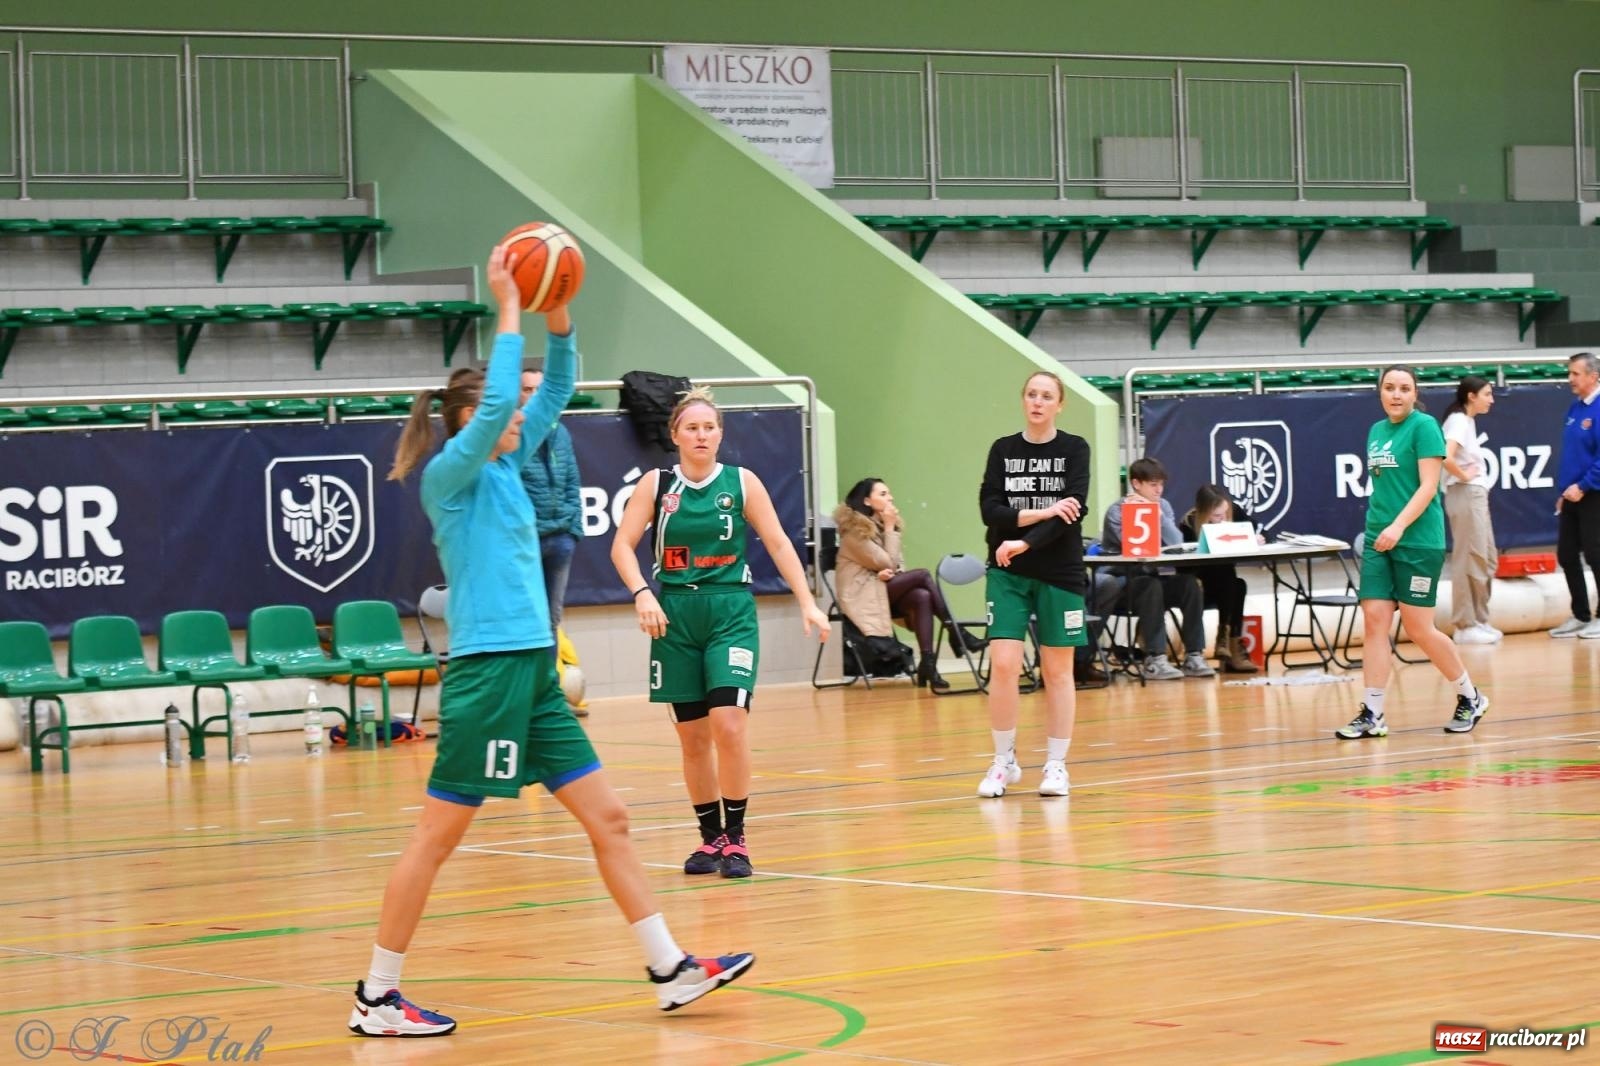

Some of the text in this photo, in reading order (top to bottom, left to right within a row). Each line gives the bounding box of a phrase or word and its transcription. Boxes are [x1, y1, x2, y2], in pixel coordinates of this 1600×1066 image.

[685, 54, 812, 85] MIESZKO
[737, 117, 789, 128] produkcyjny
[1004, 458, 1026, 473] YOU
[1028, 458, 1052, 473] CAN
[1004, 476, 1037, 492] MORE
[719, 514, 734, 541] 3
[1127, 508, 1152, 545] 5
[6, 561, 125, 591] RACIBÓRZ
[1241, 620, 1257, 653] 5
[651, 660, 662, 690] 3
[484, 739, 519, 780] 13
